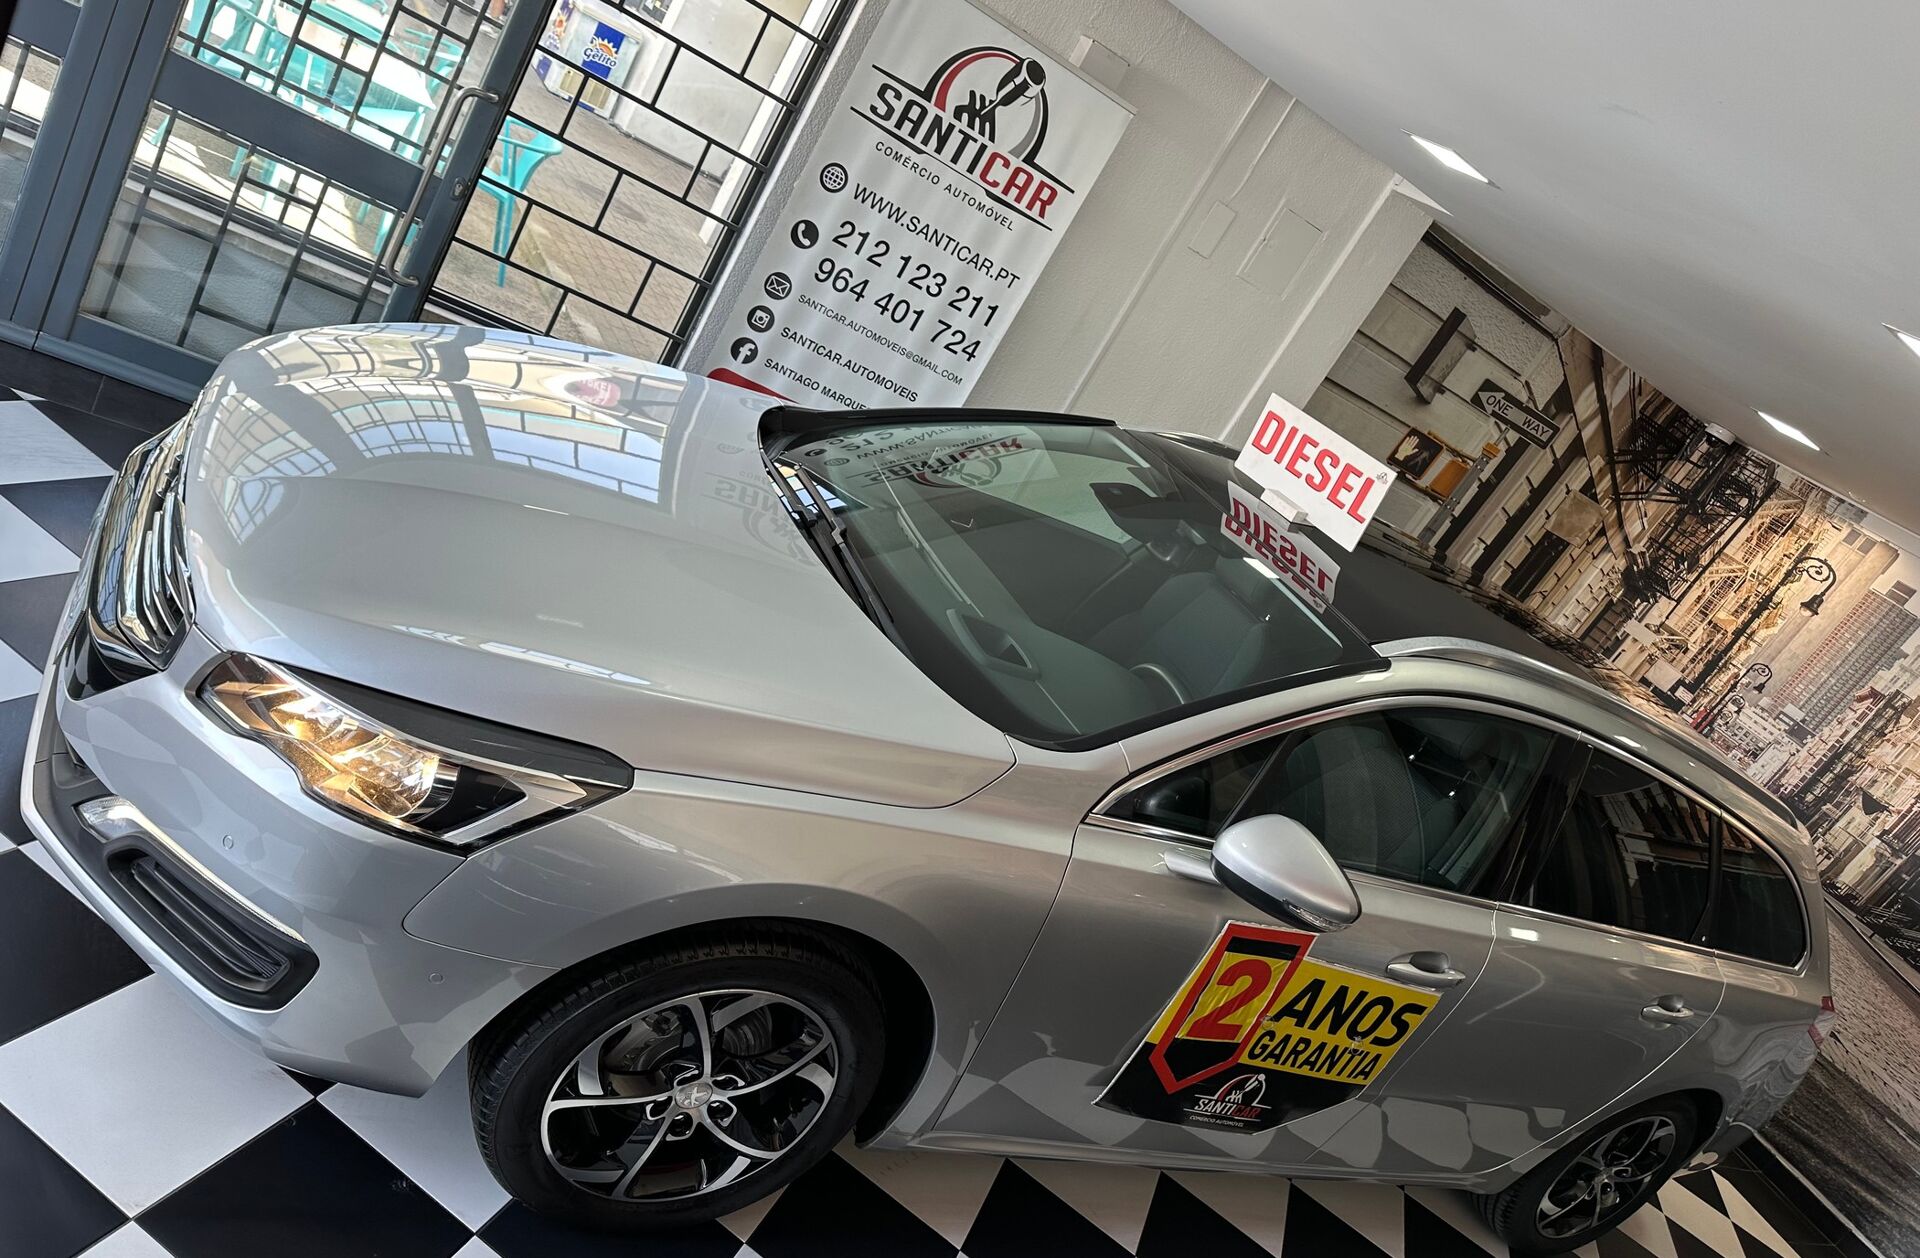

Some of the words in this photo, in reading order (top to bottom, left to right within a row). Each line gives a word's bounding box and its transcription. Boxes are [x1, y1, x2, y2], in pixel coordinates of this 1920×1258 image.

[583, 47, 617, 67] Gelito
[869, 82, 1059, 220] SANTICAR
[875, 141, 941, 186] COMÉRCIO
[943, 183, 1016, 231] AUTOMÓVEL
[832, 220, 891, 268] 212
[896, 255, 947, 298] 123
[947, 286, 1000, 327] 211
[853, 183, 1021, 289] WWW.SANTICAR.PT
[798, 294, 963, 386] SANTICAR.AUTOMOVEIS@GMAIL.COM
[814, 257, 870, 303] 964
[873, 292, 925, 332] 401
[930, 319, 982, 362] 724
[764, 358, 820, 391] SANTIAGO
[821, 386, 870, 410] MARQUE
[780, 326, 918, 403] SANTICAR.AUTOMOVEIS
[1486, 394, 1513, 416] ONE
[1521, 416, 1550, 438] WAY
[1251, 410, 1376, 524] DIESEL
[1189, 958, 1272, 1041] 2
[1269, 977, 1428, 1047] ANOS
[1247, 1029, 1382, 1081] GARANTIA
[1194, 1098, 1262, 1118] SANTICAR
